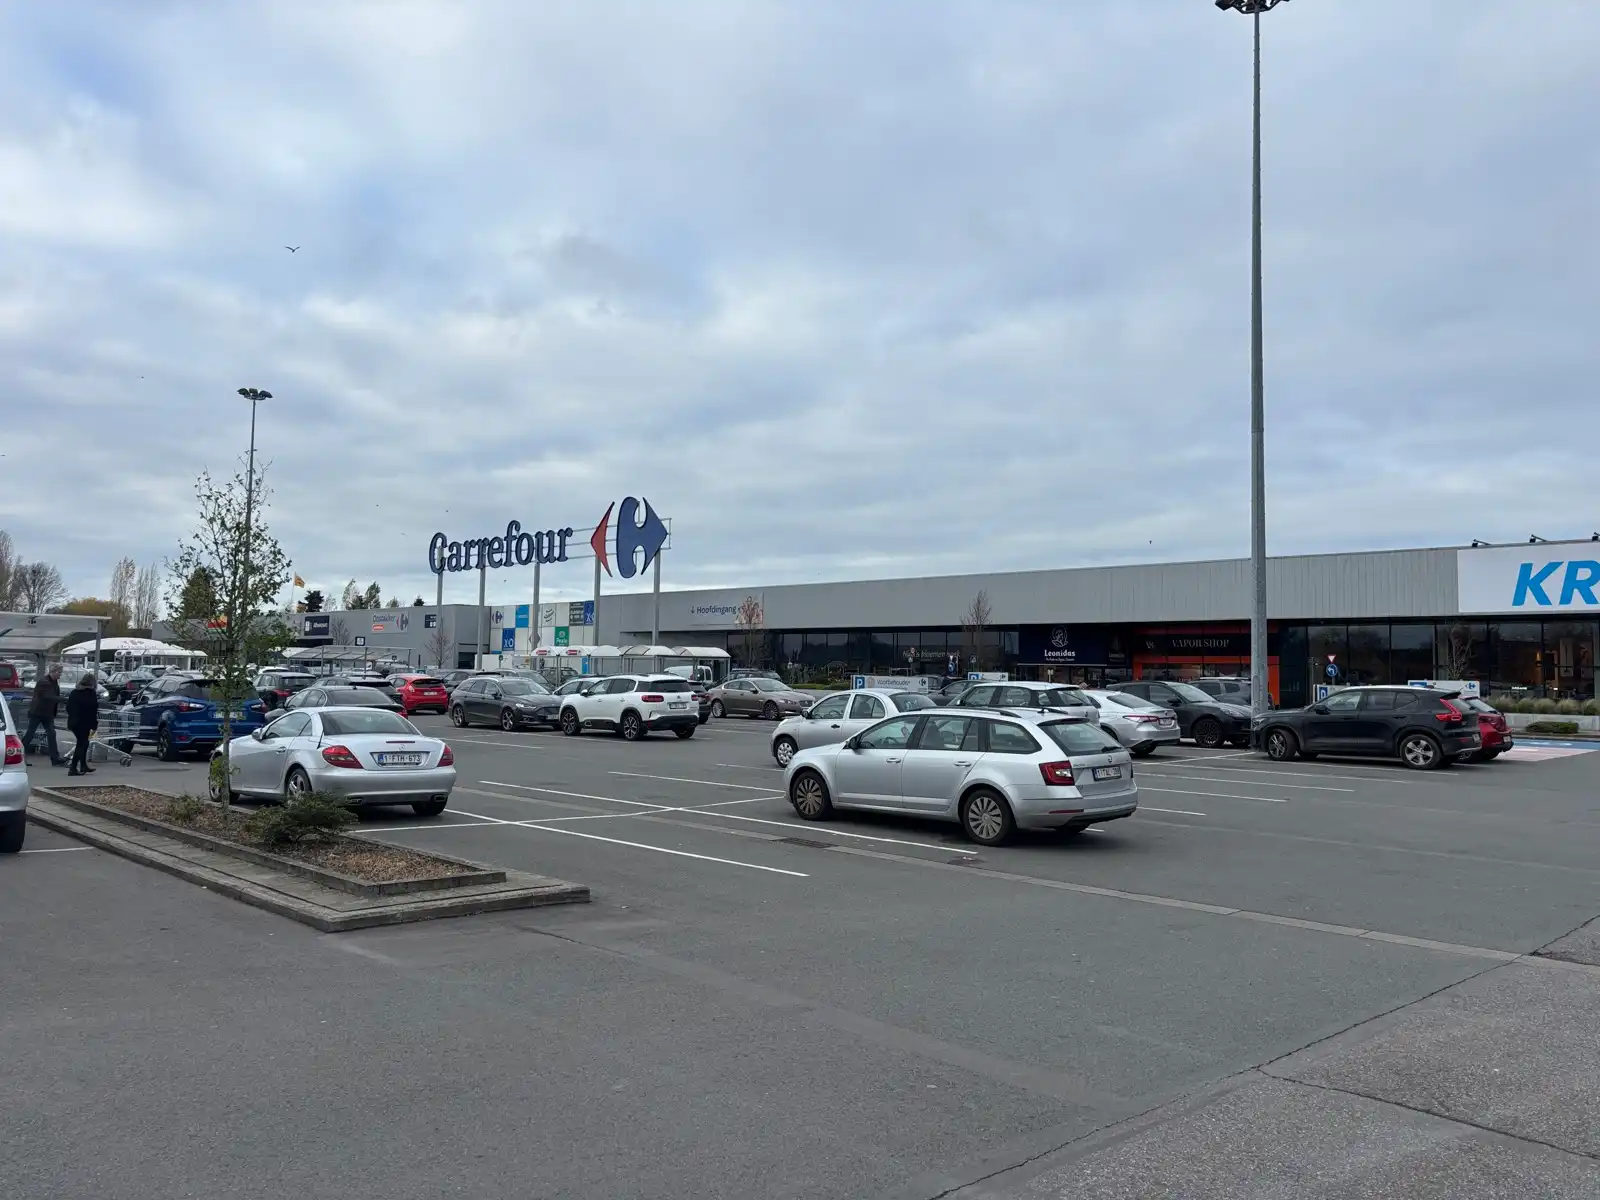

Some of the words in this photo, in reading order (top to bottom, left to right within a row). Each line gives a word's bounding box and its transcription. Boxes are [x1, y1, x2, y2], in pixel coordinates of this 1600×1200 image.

[429, 520, 573, 574] Carrefour
[697, 605, 736, 614] Hoofdingang
[1044, 649, 1076, 657] Leonidas
